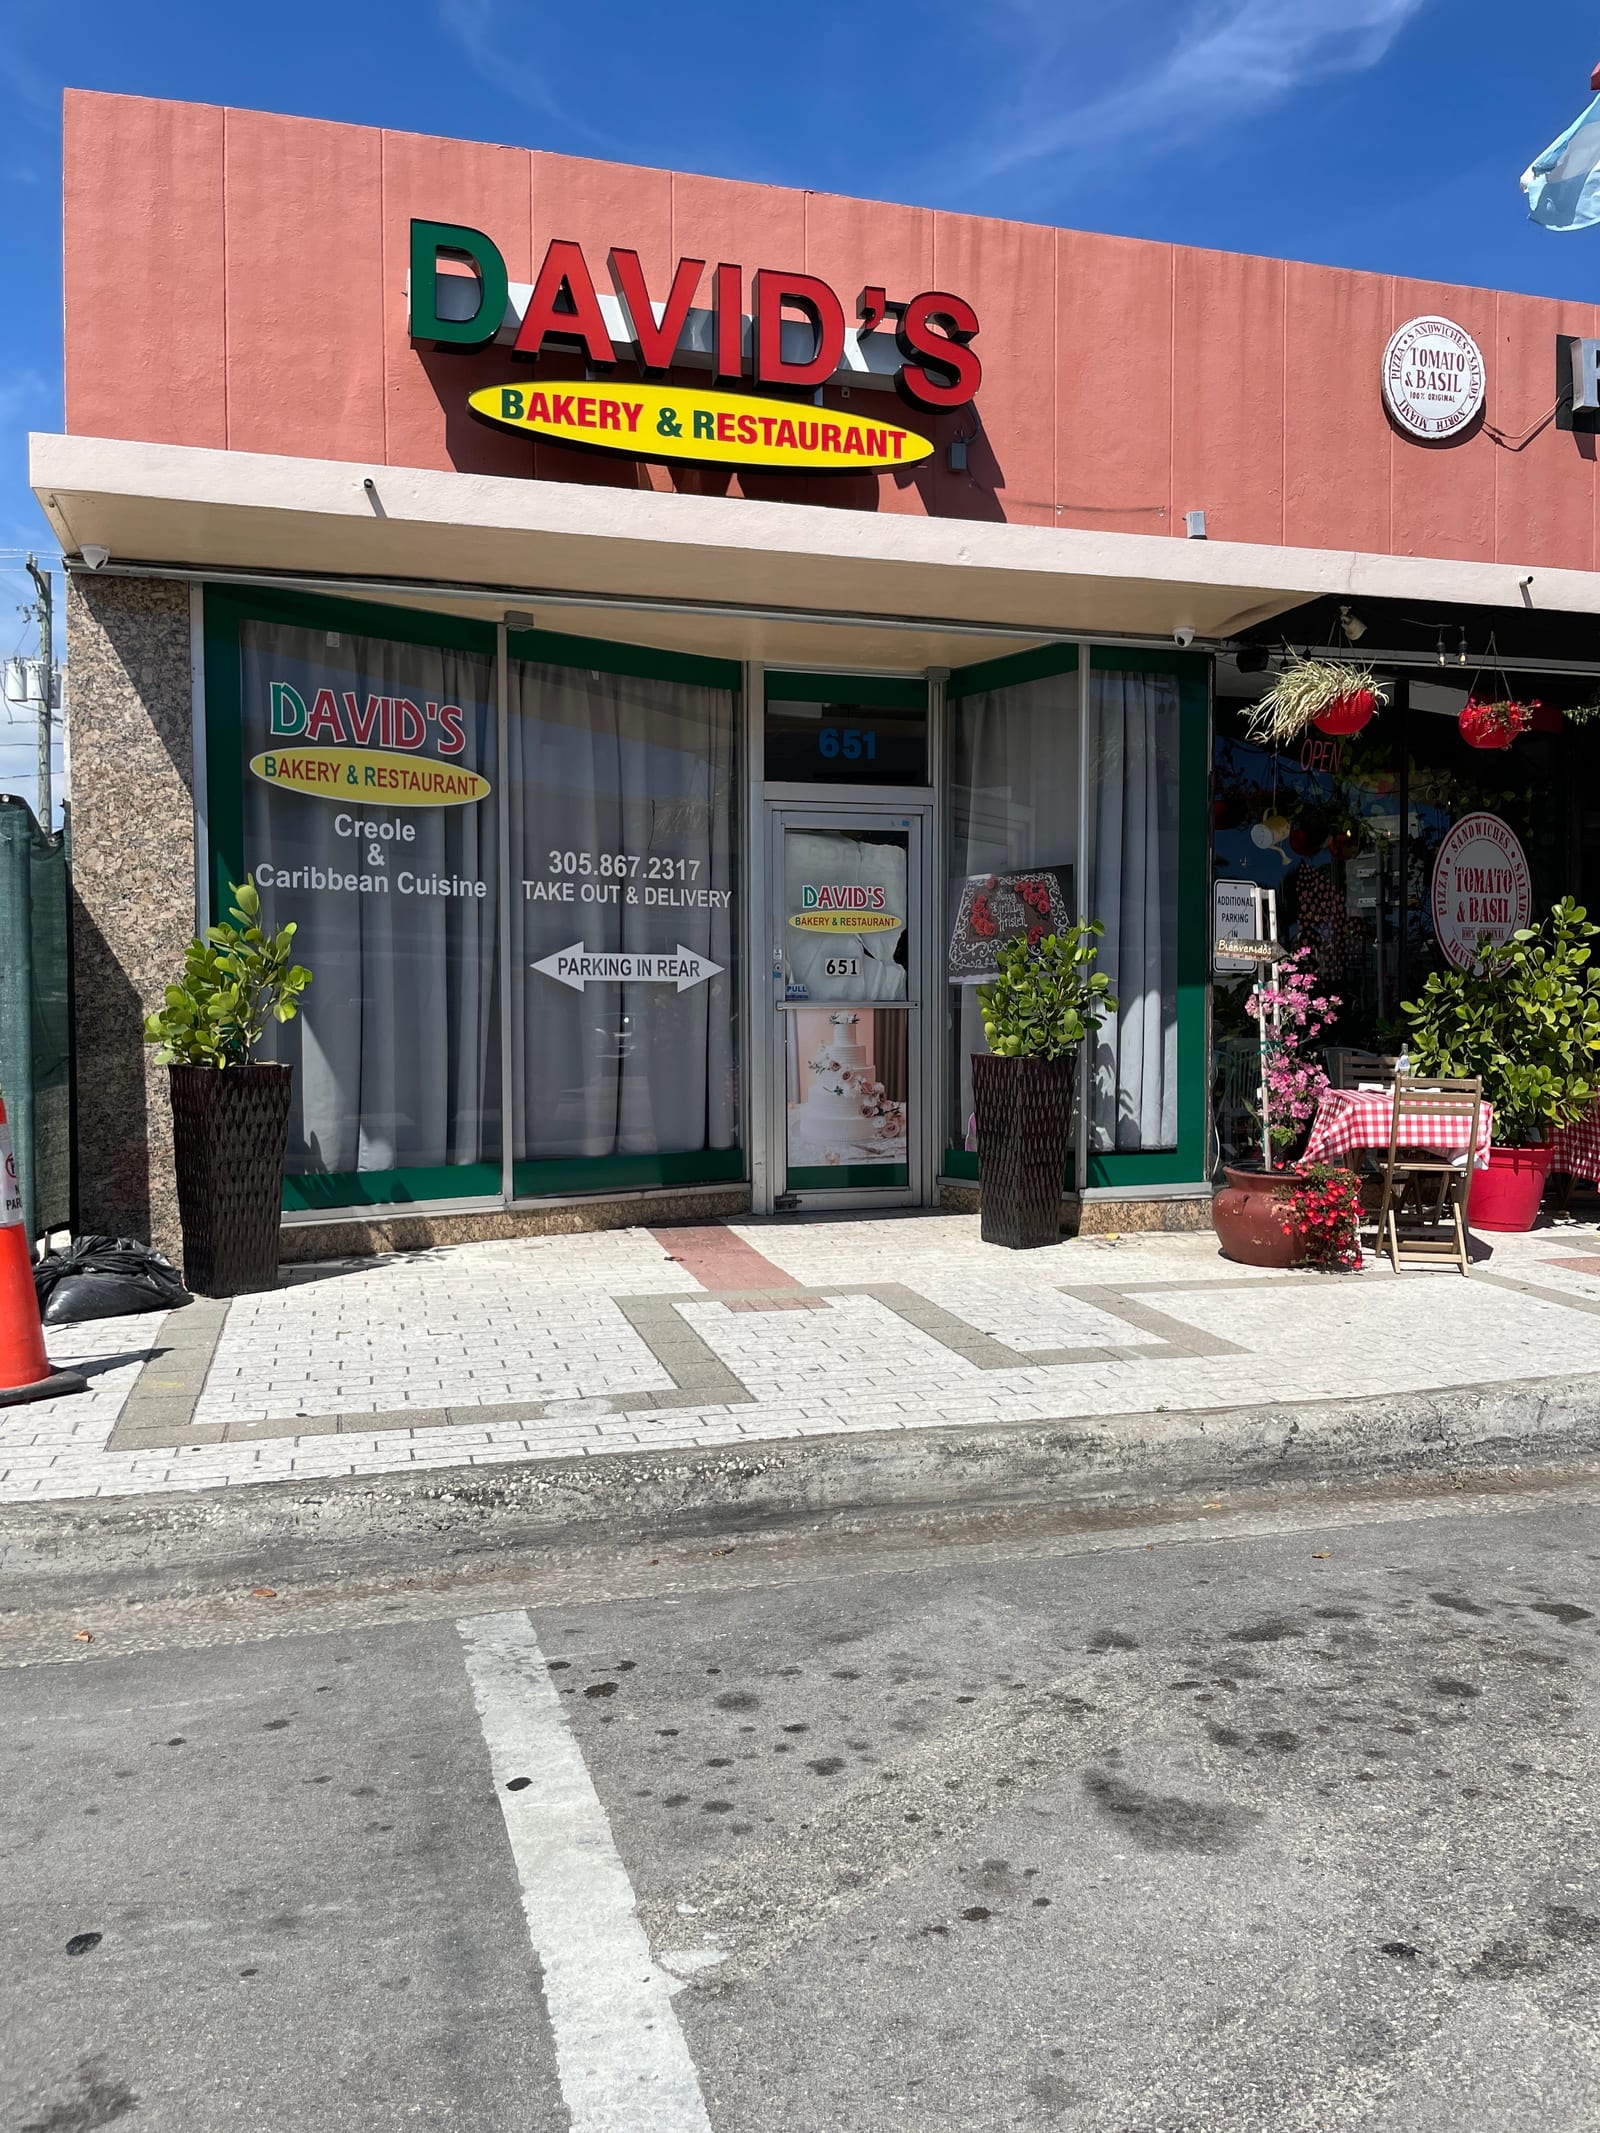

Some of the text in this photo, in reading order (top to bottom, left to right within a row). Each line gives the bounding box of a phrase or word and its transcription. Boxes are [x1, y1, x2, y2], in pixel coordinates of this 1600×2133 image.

[409, 217, 982, 410] DAVID'S
[1391, 324, 1479, 400] PIZZA SANDWICHES SALADS
[1410, 347, 1465, 372] TOMATO
[1405, 369, 1462, 393] & BASIL
[1410, 391, 1456, 403] 100% ORIGINAL
[501, 388, 907, 460] BAKERY & RESTAURANT
[1399, 399, 1466, 430] NORTH MIAMI
[269, 681, 466, 755] DAVID'S
[818, 727, 876, 759] 651
[1300, 738, 1343, 773] OPEN
[264, 756, 479, 797] BAKERY & RESTAURANT
[334, 813, 416, 842] Creole
[367, 843, 385, 866] &
[548, 850, 701, 881] 305.867.2317
[255, 863, 487, 898] Caribbean Cuisine
[1438, 822, 1527, 921] PIZZA SANDWICHES SALADS
[1454, 866, 1513, 894] TOMATO
[522, 880, 732, 909] TAKE OUT & DELIVERY
[802, 884, 886, 909] DAVID'S
[1217, 896, 1254, 907] ADDITIONAL
[795, 916, 896, 927] BAKERY & RESTAURANT
[1221, 913, 1249, 923] PARKING
[1456, 897, 1511, 923] & BASIL
[1231, 929, 1239, 938] IN
[558, 957, 701, 978] PARKING IN REAR
[826, 959, 858, 975] 651
[786, 985, 808, 993] PULL
